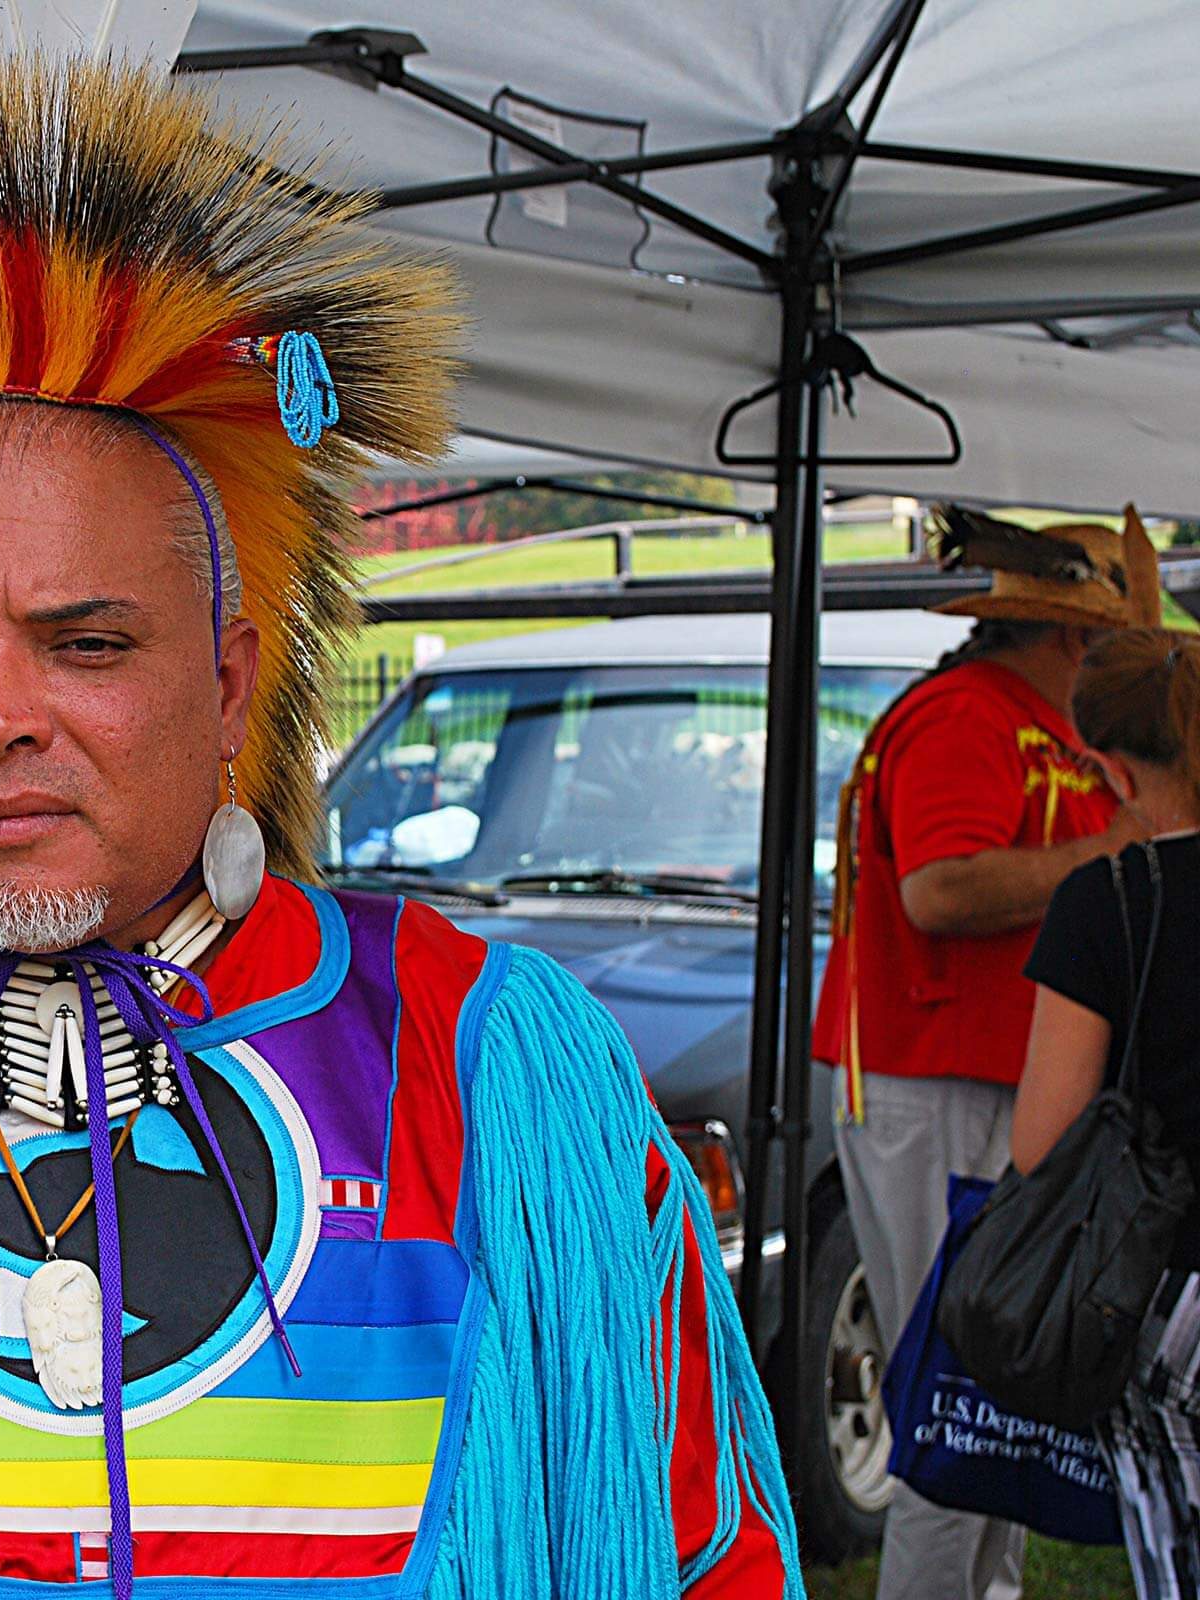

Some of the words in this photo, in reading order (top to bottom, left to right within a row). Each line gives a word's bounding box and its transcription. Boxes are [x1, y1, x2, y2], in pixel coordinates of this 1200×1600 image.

[914, 1420, 944, 1446] of
[943, 1422, 1042, 1462] Veterans
[931, 1390, 973, 1425] U.S.
[975, 1400, 1101, 1460] Departme
